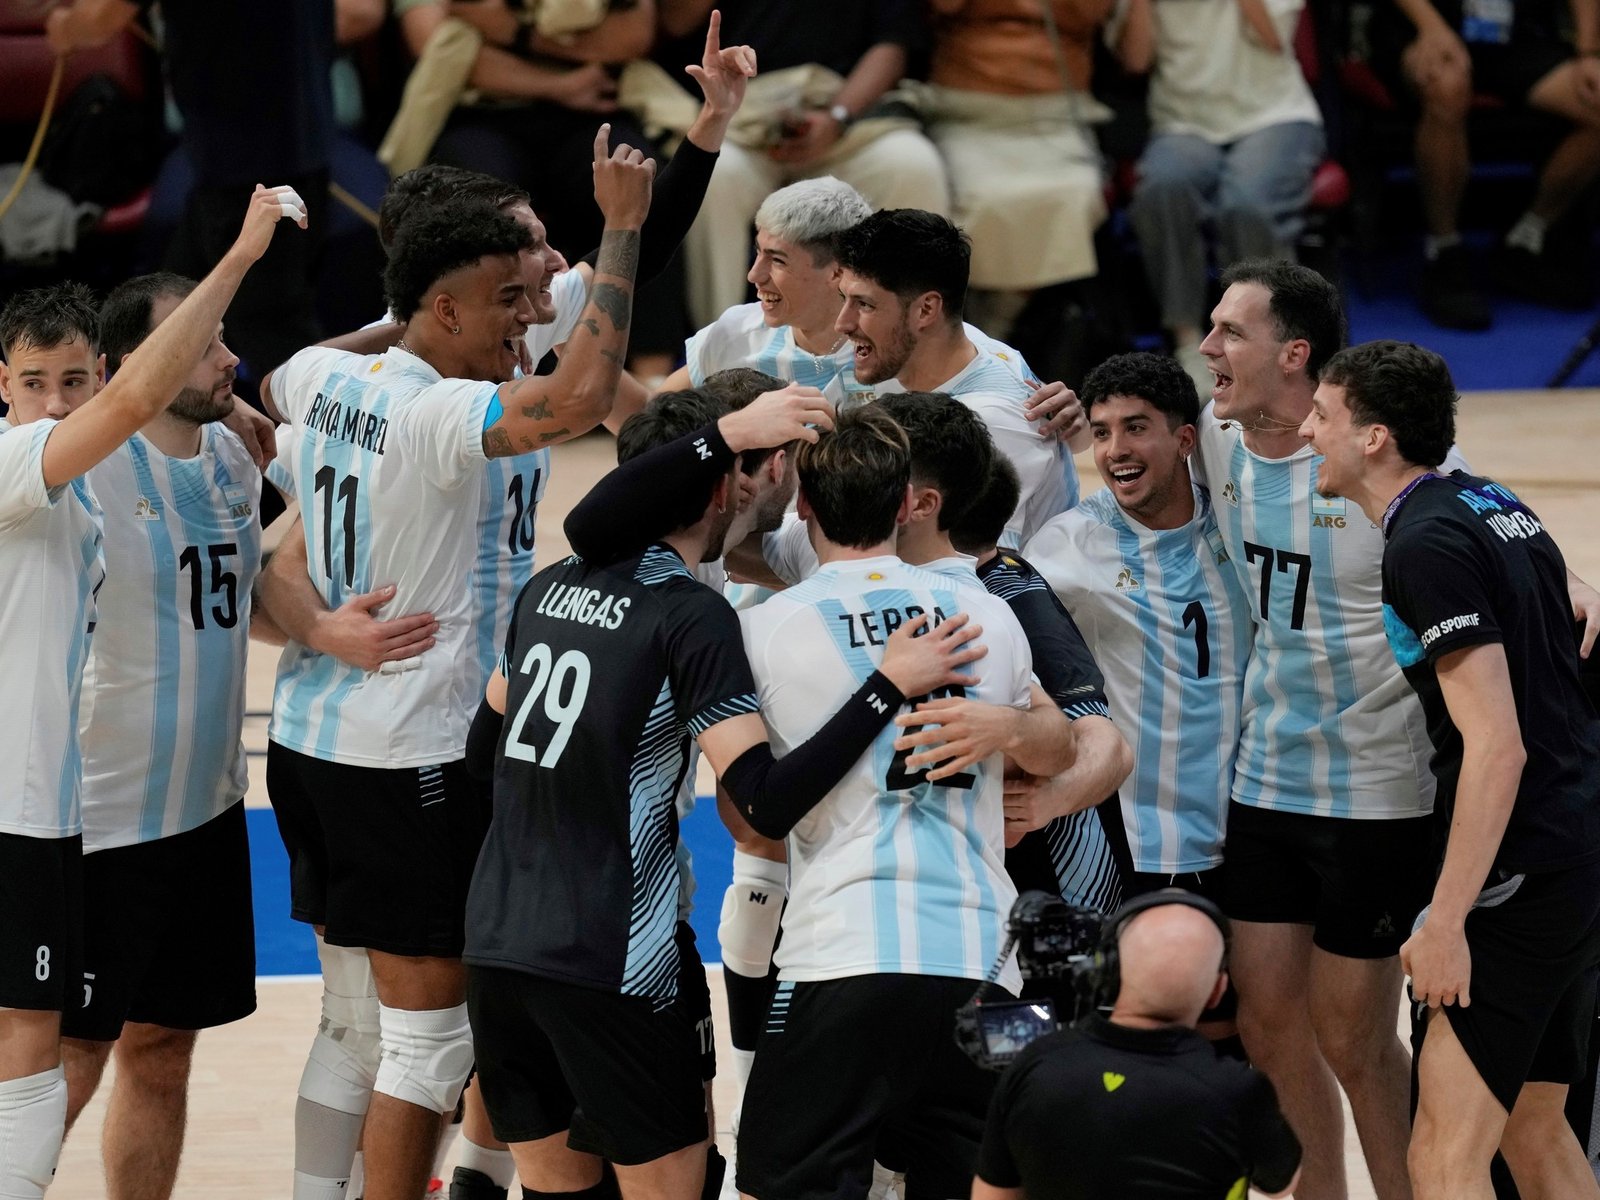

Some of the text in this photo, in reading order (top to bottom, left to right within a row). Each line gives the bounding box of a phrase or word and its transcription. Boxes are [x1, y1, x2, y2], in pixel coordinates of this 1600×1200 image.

[341, 406, 389, 456] MOREL
[232, 504, 252, 519] ARG
[314, 465, 359, 589] 11
[507, 467, 541, 556] 16
[1313, 516, 1347, 529] ARG
[179, 543, 238, 631] 15
[536, 581, 632, 630] LUENGAS
[1243, 540, 1312, 631] 77
[1181, 600, 1210, 679] 1
[1424, 625, 1442, 644] COQ
[1440, 612, 1480, 634] SPORTIF
[504, 642, 592, 769] 29
[35, 945, 51, 981] 8
